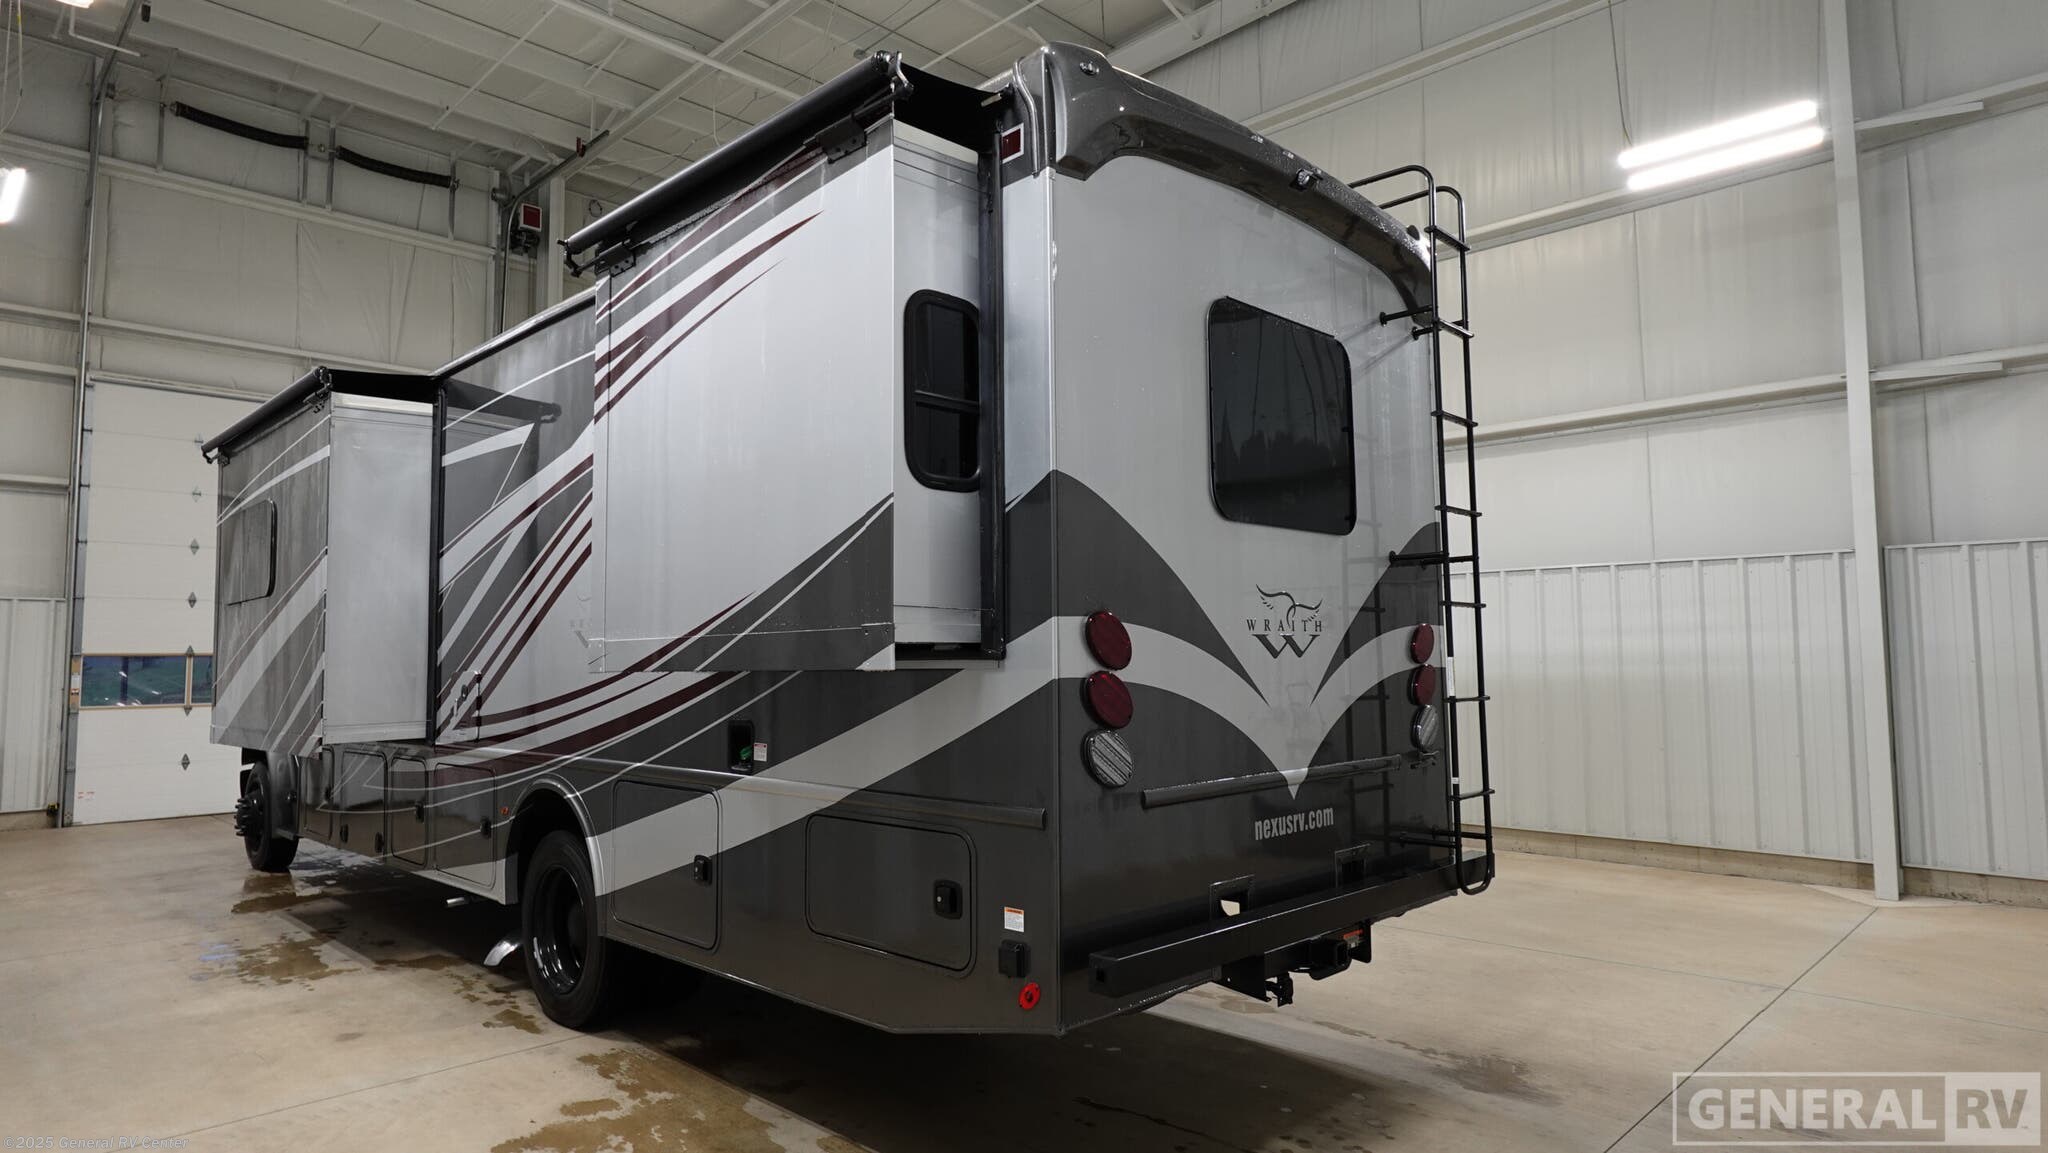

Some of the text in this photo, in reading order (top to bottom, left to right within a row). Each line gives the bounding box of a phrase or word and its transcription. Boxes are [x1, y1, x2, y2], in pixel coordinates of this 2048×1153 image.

[1246, 618, 1322, 633] WRAITH
[1252, 633, 1321, 659] W
[1254, 807, 1335, 841] nexusrv.com
